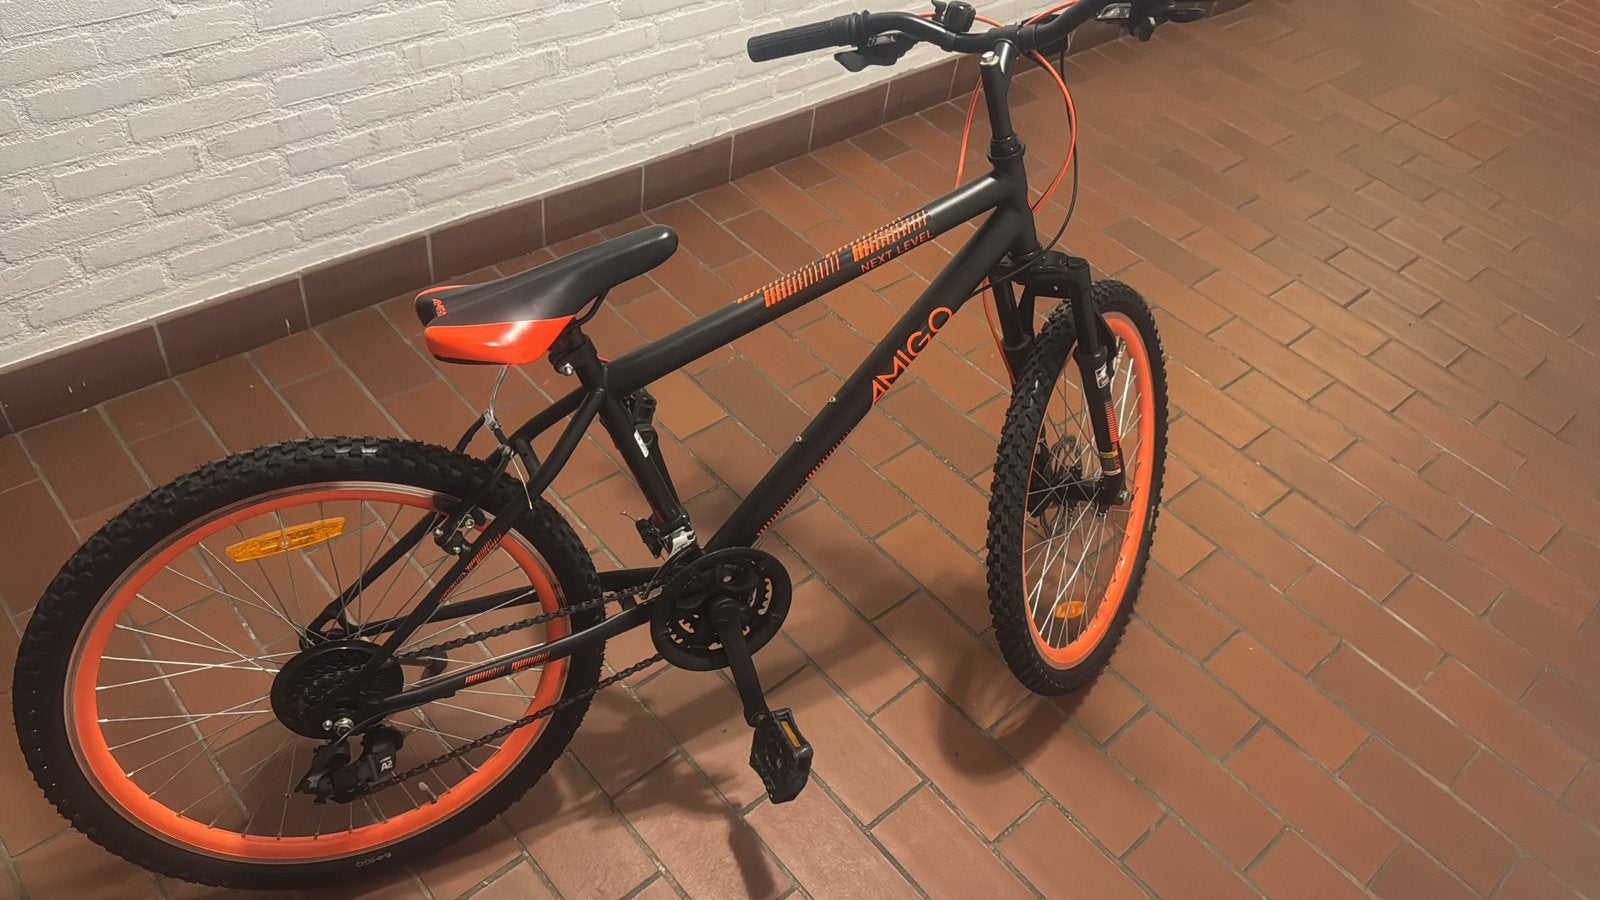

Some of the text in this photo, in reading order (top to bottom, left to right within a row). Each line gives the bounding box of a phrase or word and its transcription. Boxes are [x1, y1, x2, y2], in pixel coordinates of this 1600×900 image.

[860, 230, 934, 273] NEXT LEVEL
[872, 306, 953, 406] AMIGO
[381, 760, 393, 772] A2
